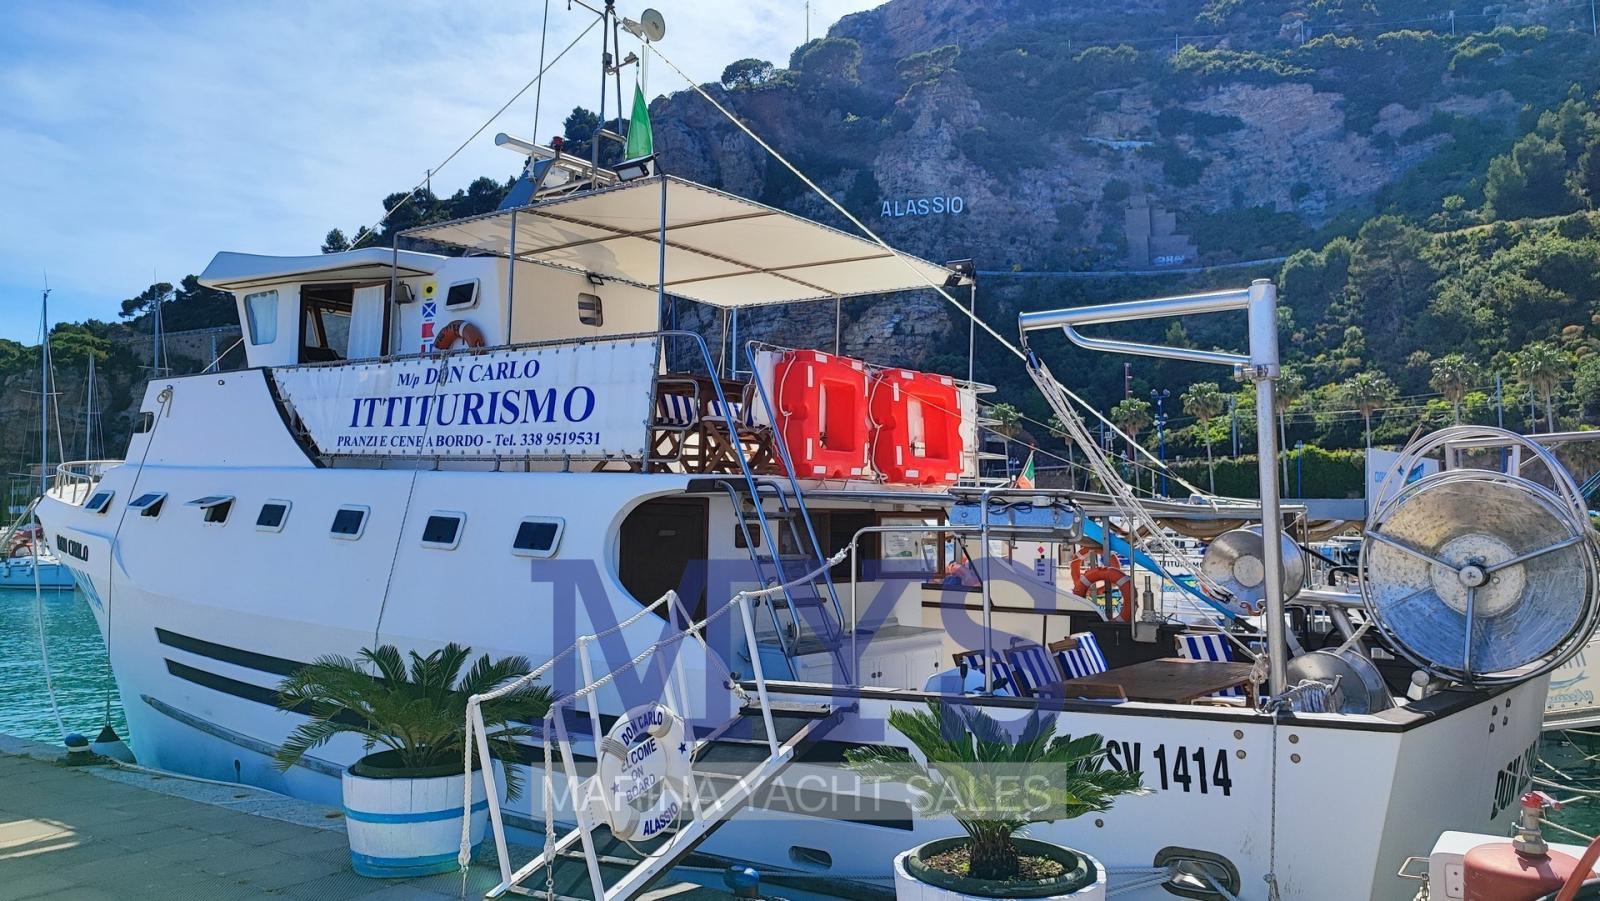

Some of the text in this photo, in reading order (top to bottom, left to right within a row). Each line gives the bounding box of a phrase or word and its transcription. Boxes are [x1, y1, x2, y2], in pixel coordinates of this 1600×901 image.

[880, 196, 964, 217] ALASSIO
[397, 372, 420, 389] M/p
[468, 359, 540, 383] CARLO
[348, 386, 596, 428] ITTITURISMO
[337, 435, 378, 447] PRANZI
[380, 436, 388, 447] E
[390, 436, 423, 447] CENE
[426, 436, 433, 447] A
[436, 434, 483, 447] BORDO
[495, 434, 516, 446] Tel.
[520, 433, 543, 446] 338
[546, 431, 600, 445] 9519531
[621, 711, 663, 747] DON CARLO
[621, 738, 657, 772] ELCOME
[1153, 744, 1233, 797] 1414
[626, 774, 656, 802] BOARD
[631, 766, 645, 781] ON
[643, 801, 679, 836] ALASSIO
